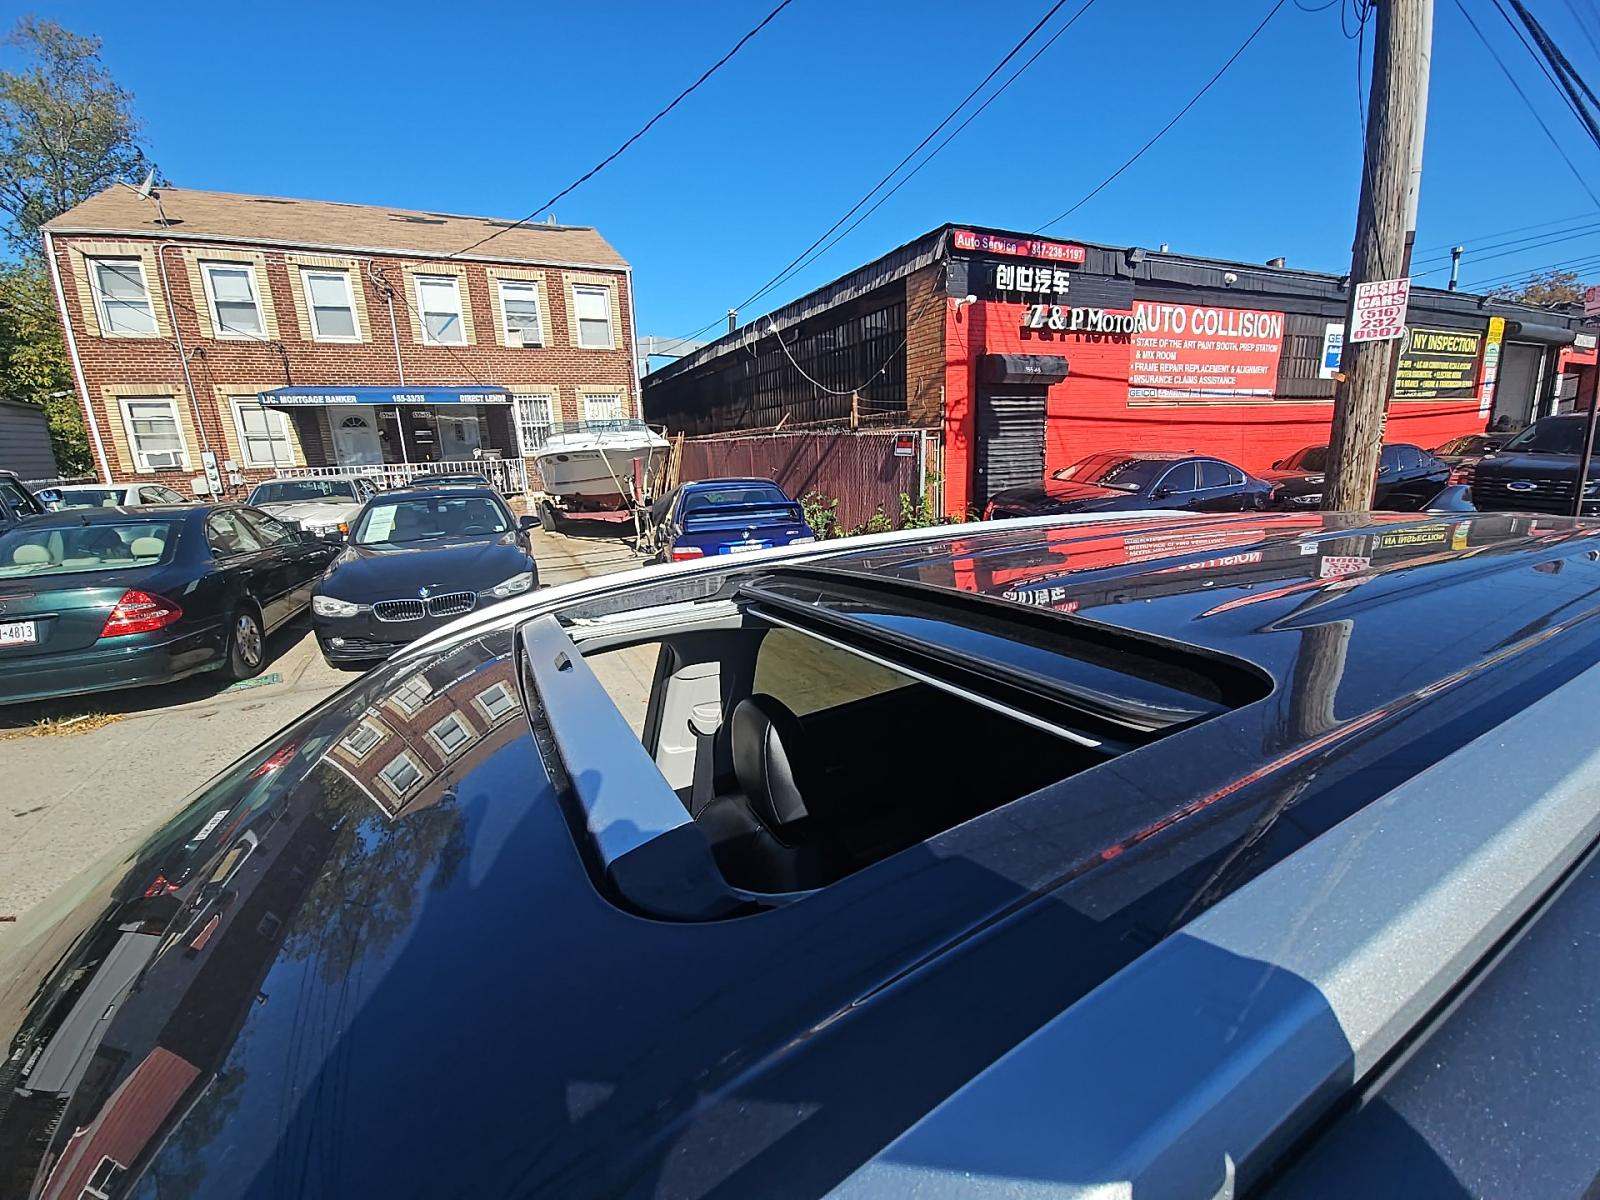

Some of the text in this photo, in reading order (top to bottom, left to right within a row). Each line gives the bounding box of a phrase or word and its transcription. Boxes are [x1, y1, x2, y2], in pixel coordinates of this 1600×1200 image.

[957, 233, 1084, 260] Auto Service 347-238-1197
[996, 264, 1070, 294] 创世汽车
[1358, 293, 1405, 309] CARS
[1029, 304, 1044, 328] Z
[1048, 305, 1066, 330] &
[1070, 307, 1084, 331] P
[1360, 306, 1400, 319] (516)
[1135, 303, 1282, 339] AUTO COLLISION
[1360, 317, 1397, 329] 232
[1136, 338, 1158, 347] STATE
[1159, 339, 1168, 347] OF
[1168, 340, 1182, 348] THE
[1183, 340, 1196, 349] ART
[1197, 341, 1216, 349] PAINT
[1413, 334, 1477, 352] NY INSPECTION
[1134, 362, 1159, 372] FRAME
[1160, 363, 1184, 372] REPAIR
[1184, 363, 1230, 373] REPLACEMENT
[1236, 365, 1269, 374] ALIGNMENT
[1133, 375, 1237, 385] INSURANCE CLAIMS ASSISTANCE
[280, 395, 324, 404] MORTGAGE
[325, 395, 357, 403] BANKER
[459, 394, 484, 403] DIRECT
